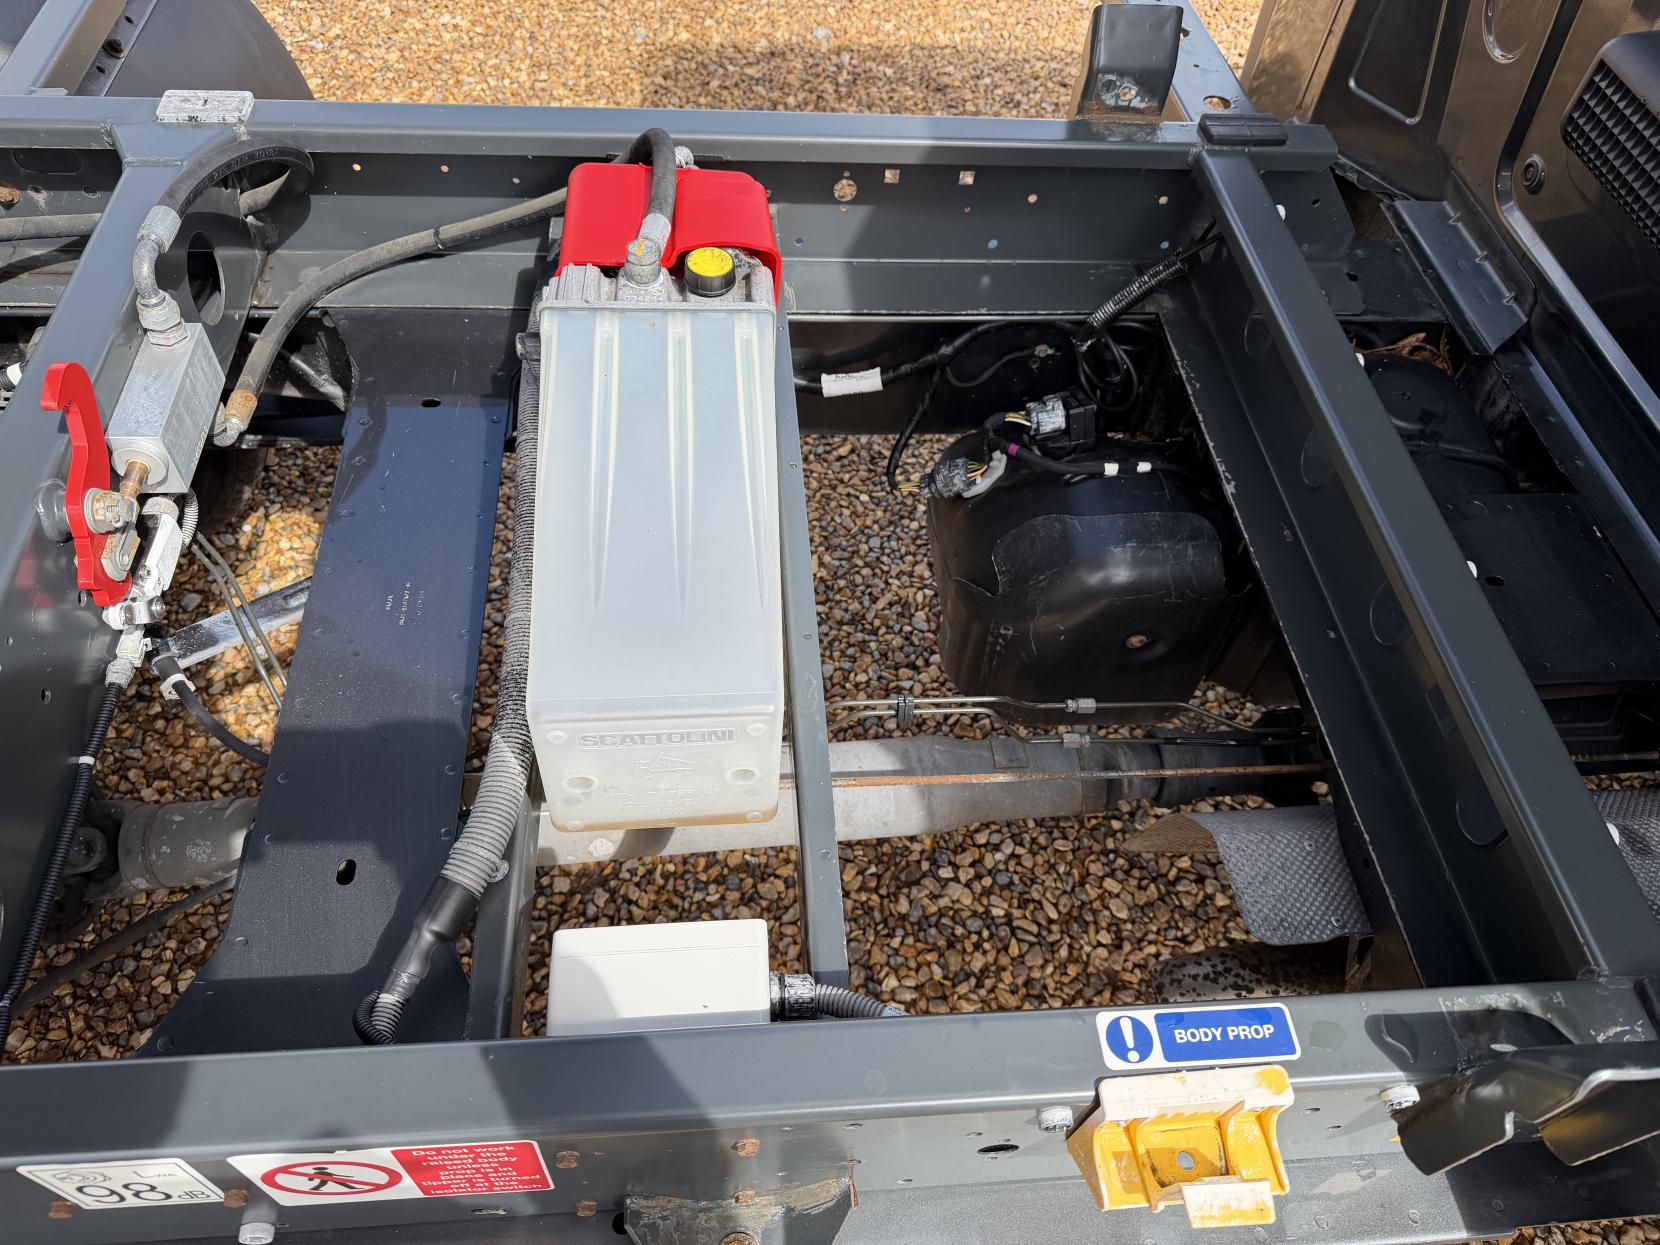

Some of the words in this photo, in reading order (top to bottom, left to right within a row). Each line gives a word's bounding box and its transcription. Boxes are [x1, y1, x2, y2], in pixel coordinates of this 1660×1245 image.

[579, 729, 734, 747] SCATTOLINI
[1174, 1026, 1222, 1043] BODY
[1227, 1024, 1274, 1040] PROP
[75, 1182, 173, 1204] 98
[177, 1190, 211, 1200] dB
